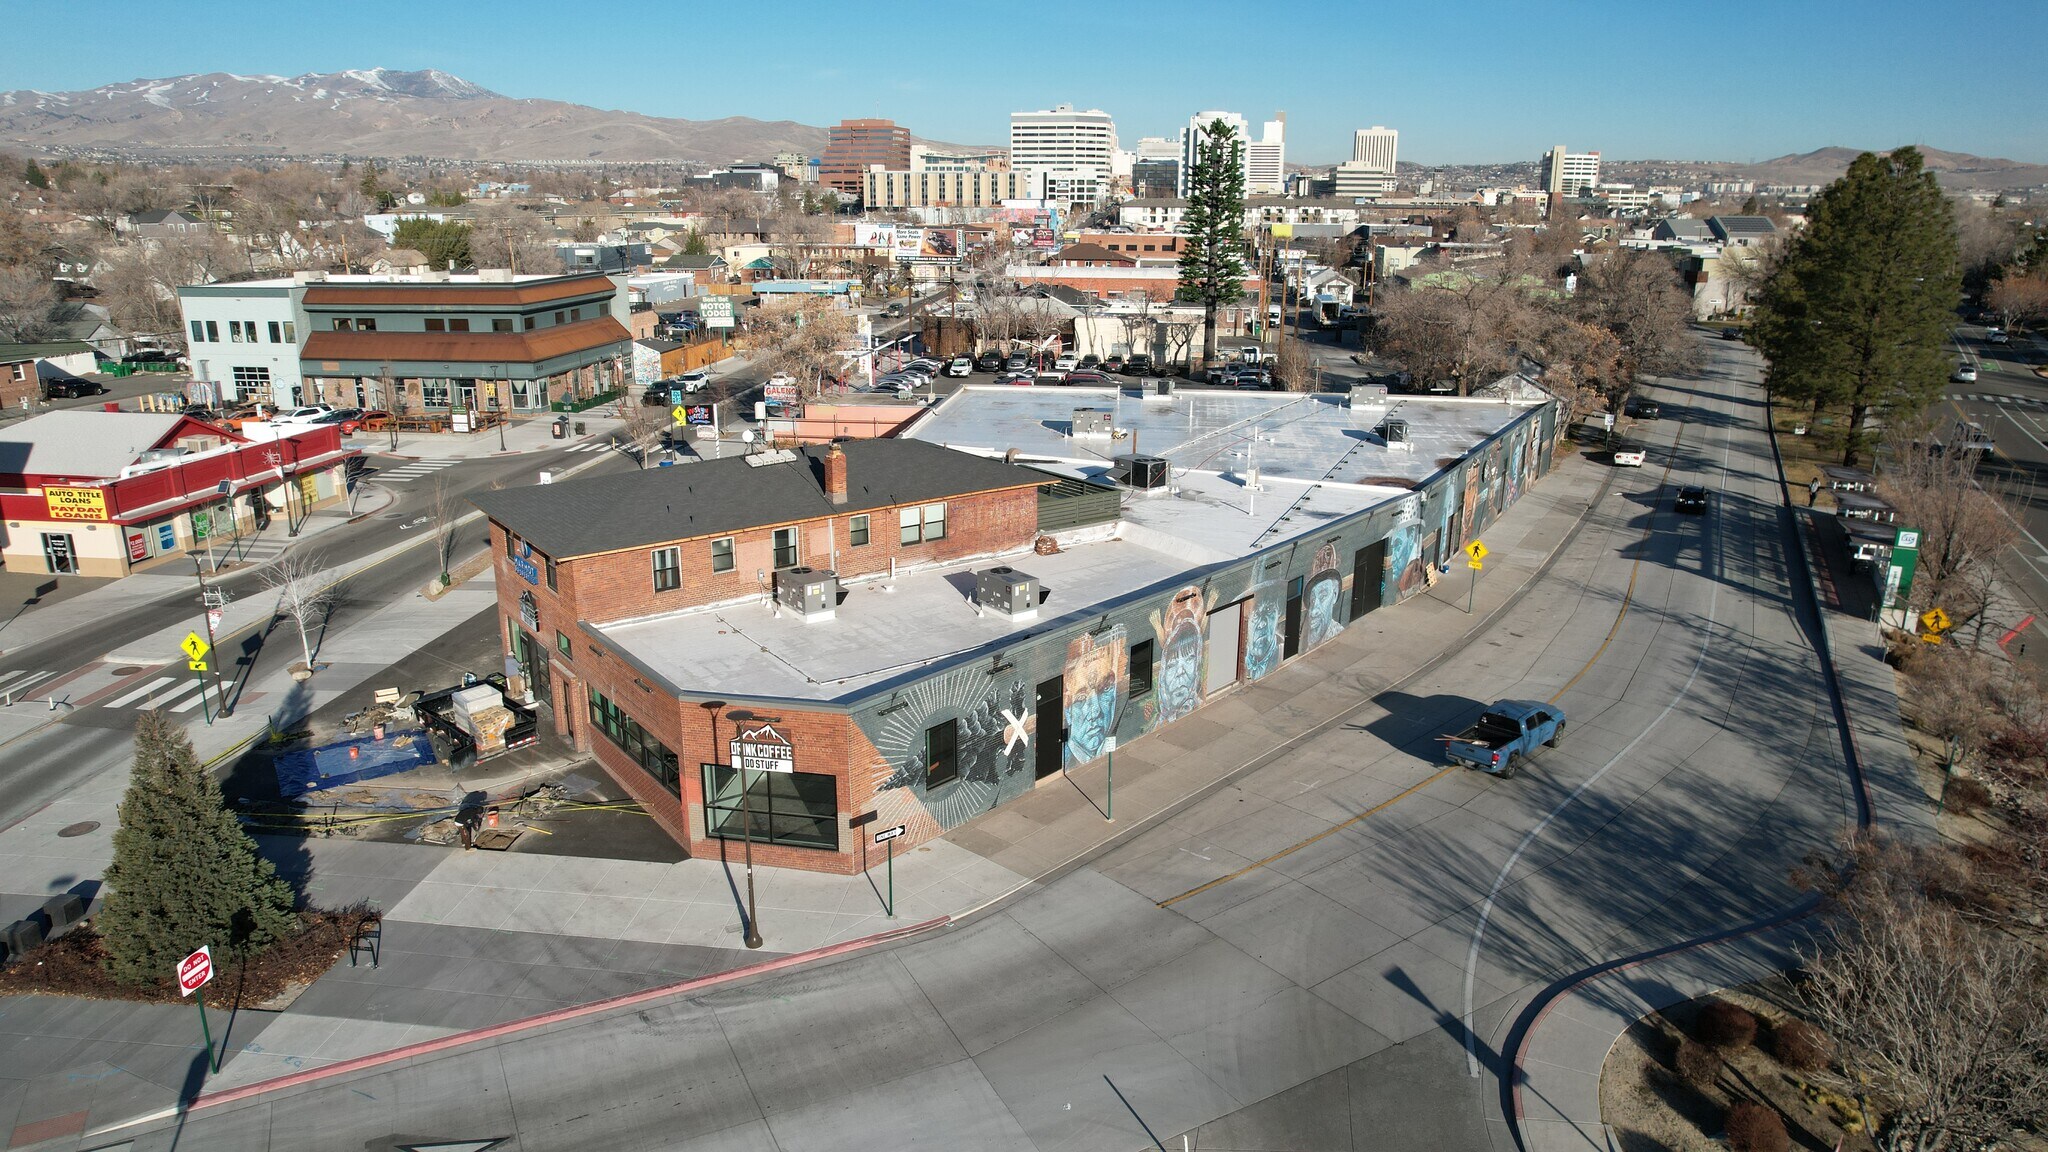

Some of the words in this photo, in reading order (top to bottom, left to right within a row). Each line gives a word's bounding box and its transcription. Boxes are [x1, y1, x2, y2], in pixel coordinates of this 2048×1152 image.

[49, 490, 73, 498] AUTO
[77, 491, 101, 499] TITLE
[50, 505, 104, 513] PAYDAY
[757, 744, 793, 760] COFFEE
[745, 758, 755, 768] DO
[755, 759, 779, 770] STUFF
[183, 963, 192, 972] DO
[193, 954, 205, 966] NOT
[188, 970, 206, 986] ENTER
